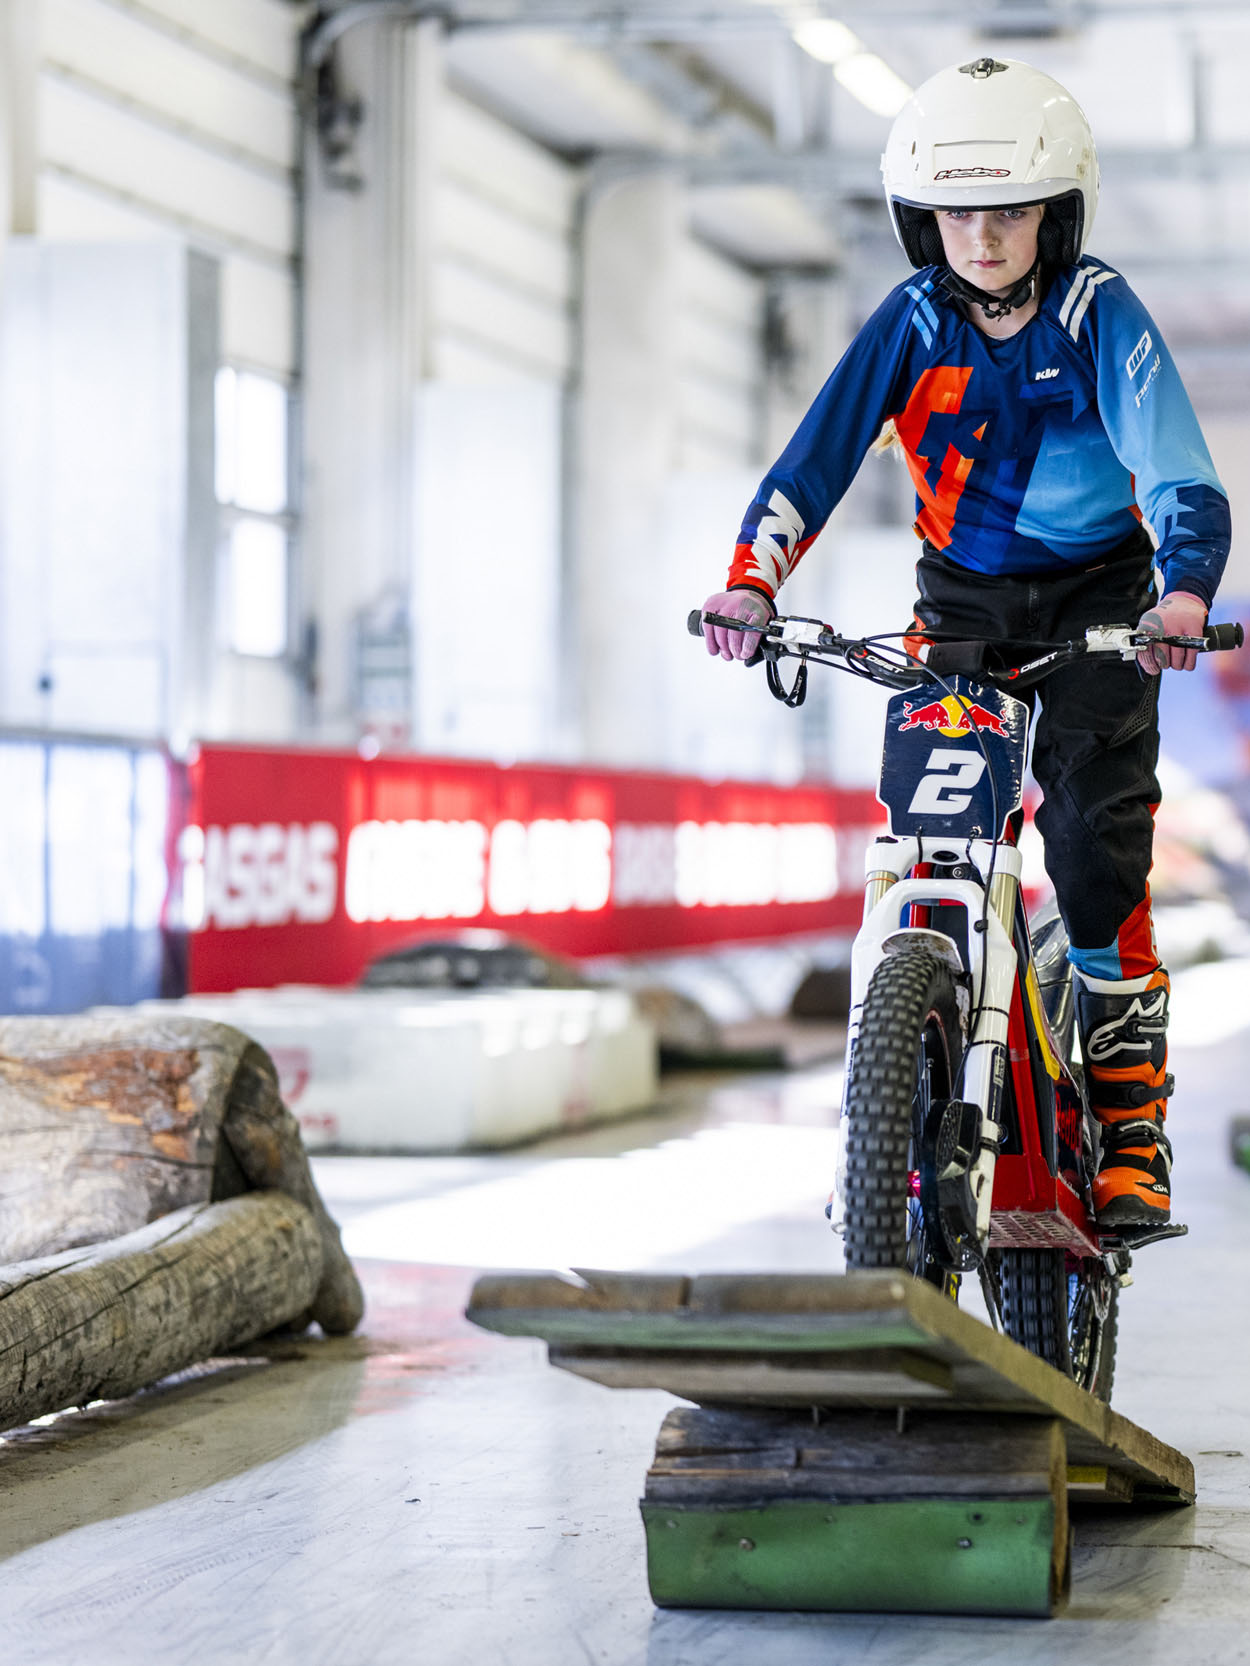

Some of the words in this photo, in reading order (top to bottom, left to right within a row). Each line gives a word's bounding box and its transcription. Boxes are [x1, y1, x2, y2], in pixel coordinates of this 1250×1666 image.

[866, 655, 905, 674] OSET
[1020, 651, 1058, 674] OSET
[907, 748, 987, 815] 2
